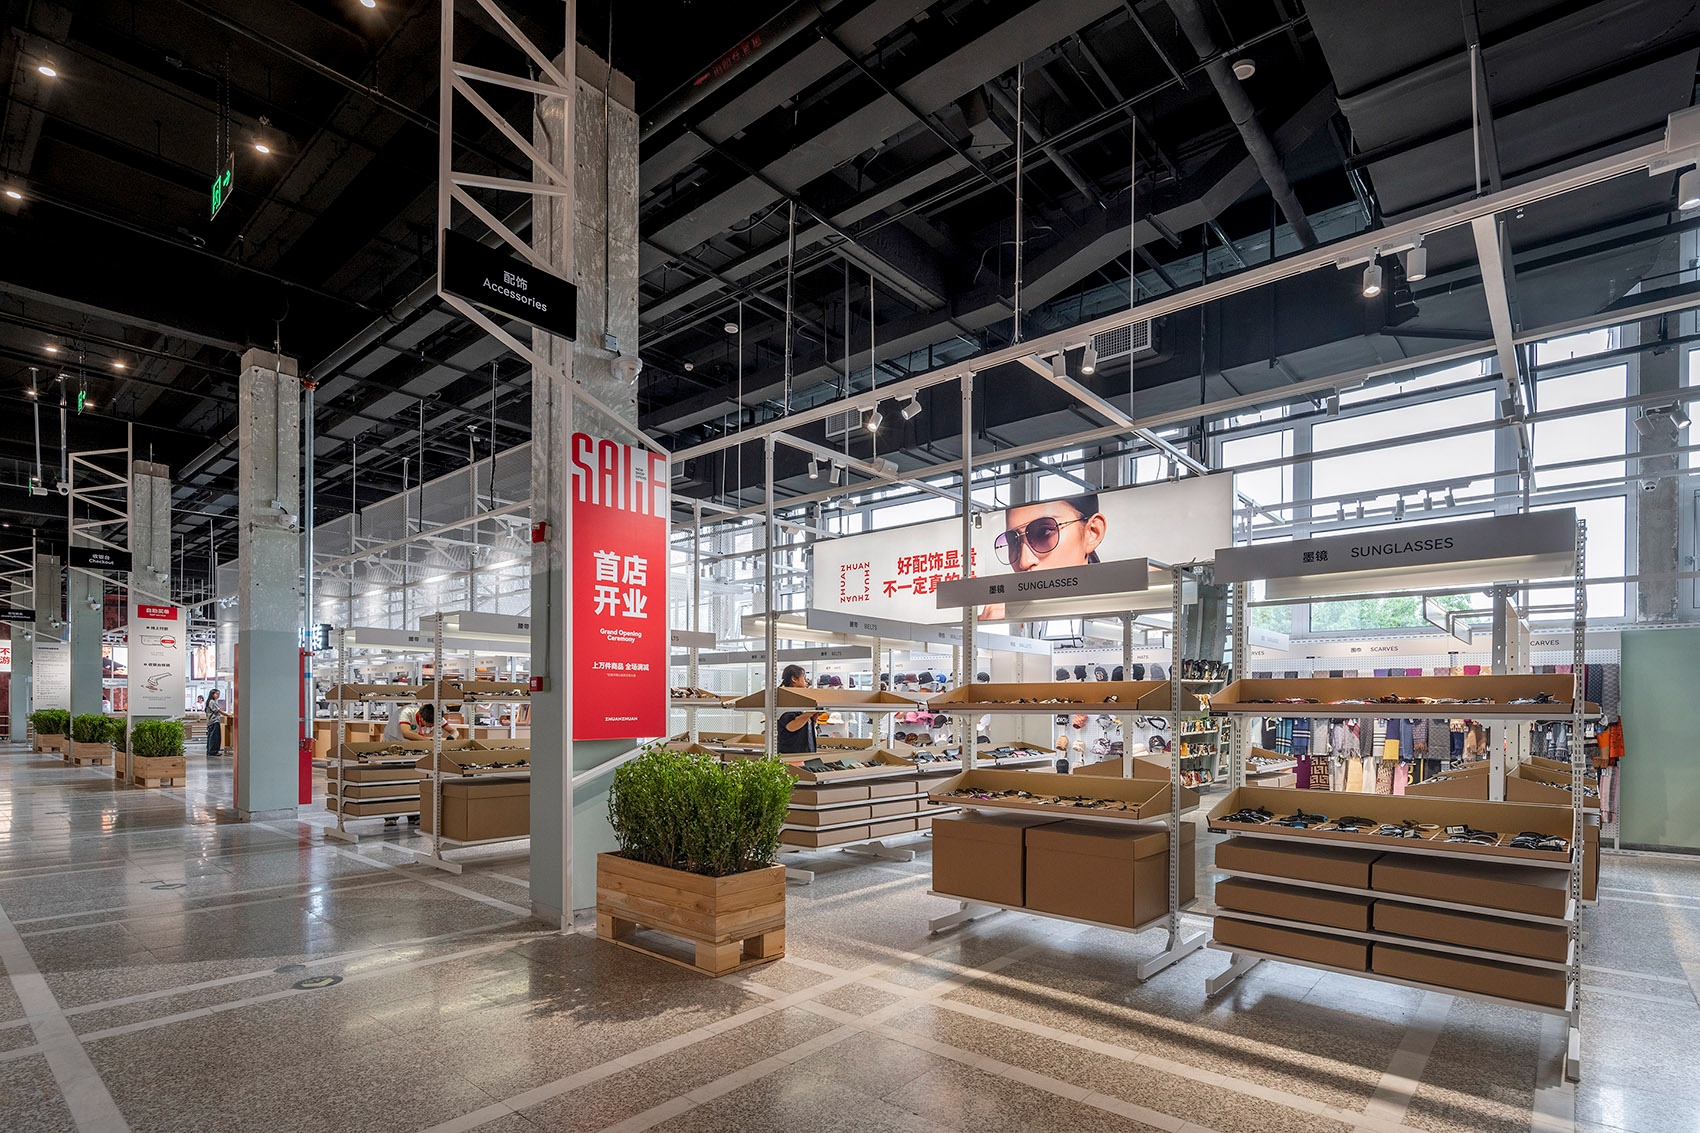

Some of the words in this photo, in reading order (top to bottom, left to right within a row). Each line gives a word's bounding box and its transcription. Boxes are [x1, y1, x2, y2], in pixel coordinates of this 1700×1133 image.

[503, 270, 528, 291] 配饰
[483, 278, 547, 312] Accessories
[1303, 550, 1329, 563] 墨镜
[1351, 537, 1454, 558] SUNGLASSES
[88, 558, 114, 566] Checkout
[593, 549, 648, 587] 首店
[840, 561, 870, 572] ZHUAN
[1018, 577, 1078, 591] SUNGLASSES
[593, 584, 648, 619] 开业
[600, 627, 618, 636] Grand
[618, 629, 642, 639] Opening
[864, 623, 878, 631] BELTS
[607, 634, 635, 643] Ceremony
[592, 661, 624, 670] 上万件商品
